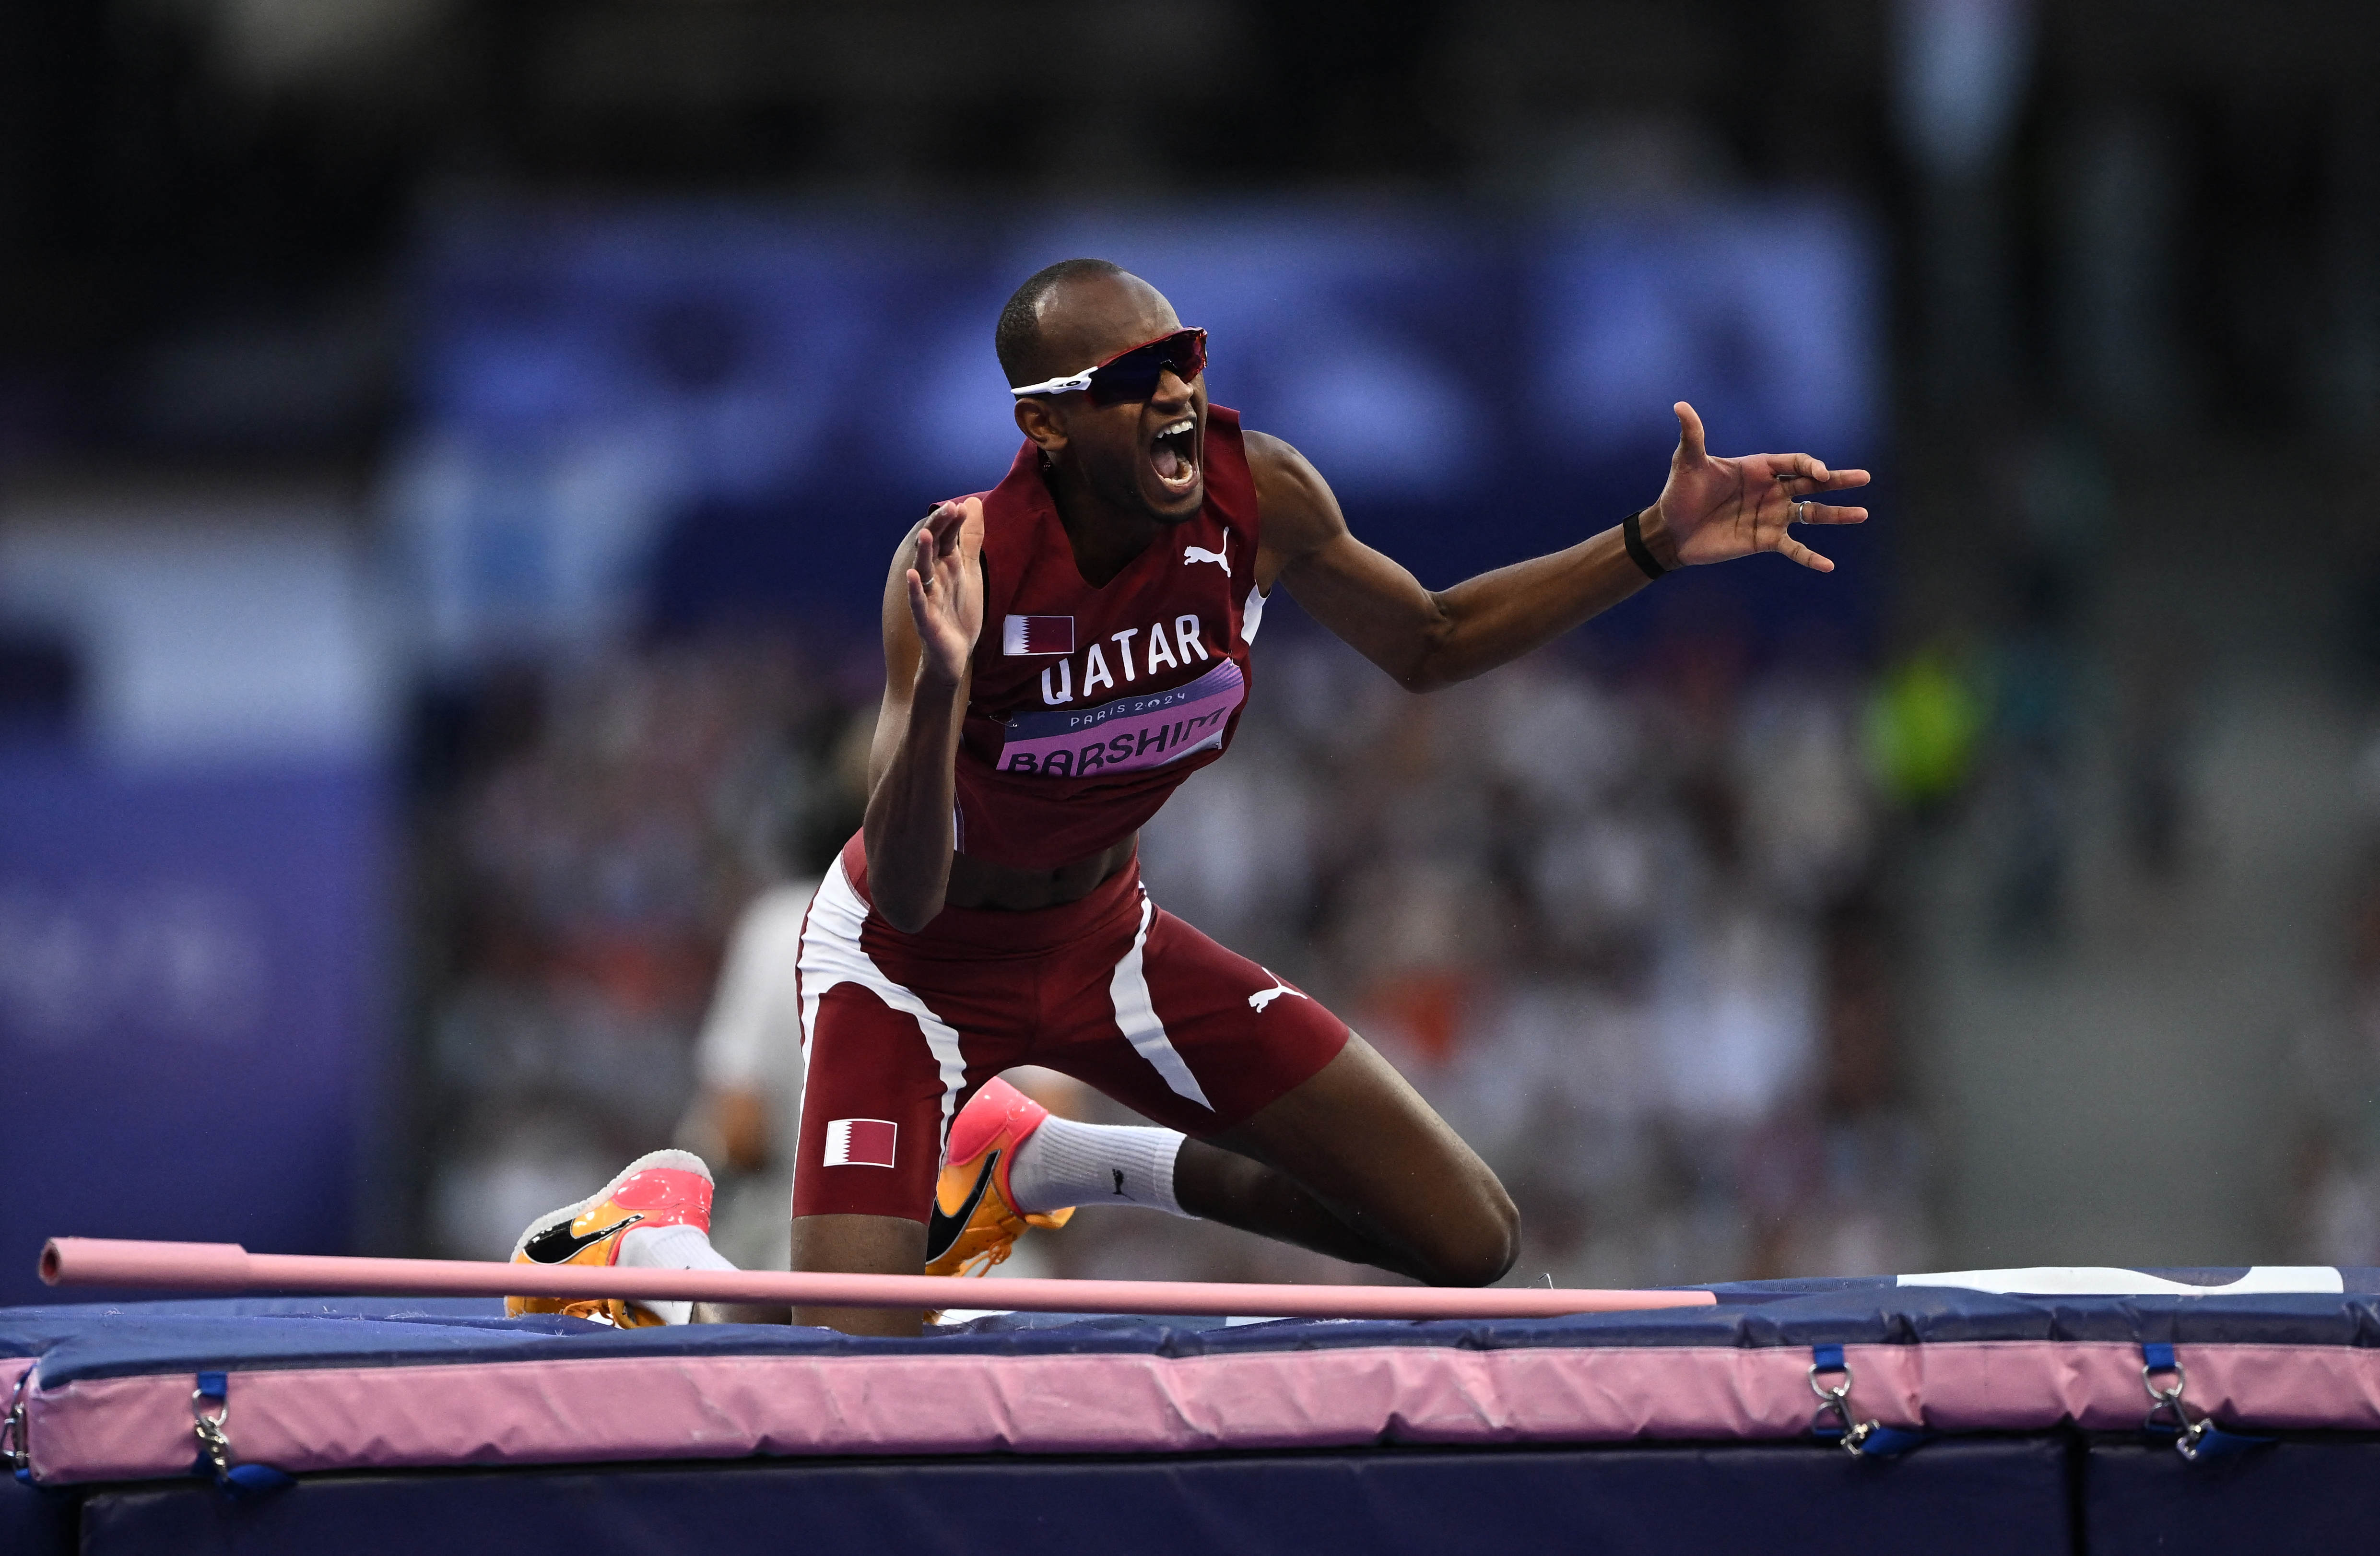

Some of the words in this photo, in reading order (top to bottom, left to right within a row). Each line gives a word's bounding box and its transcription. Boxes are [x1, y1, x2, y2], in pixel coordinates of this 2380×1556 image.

[1041, 614, 1208, 705] QATAR
[1134, 693, 1185, 711] 2024
[1007, 706, 1227, 777] BARSHIM
